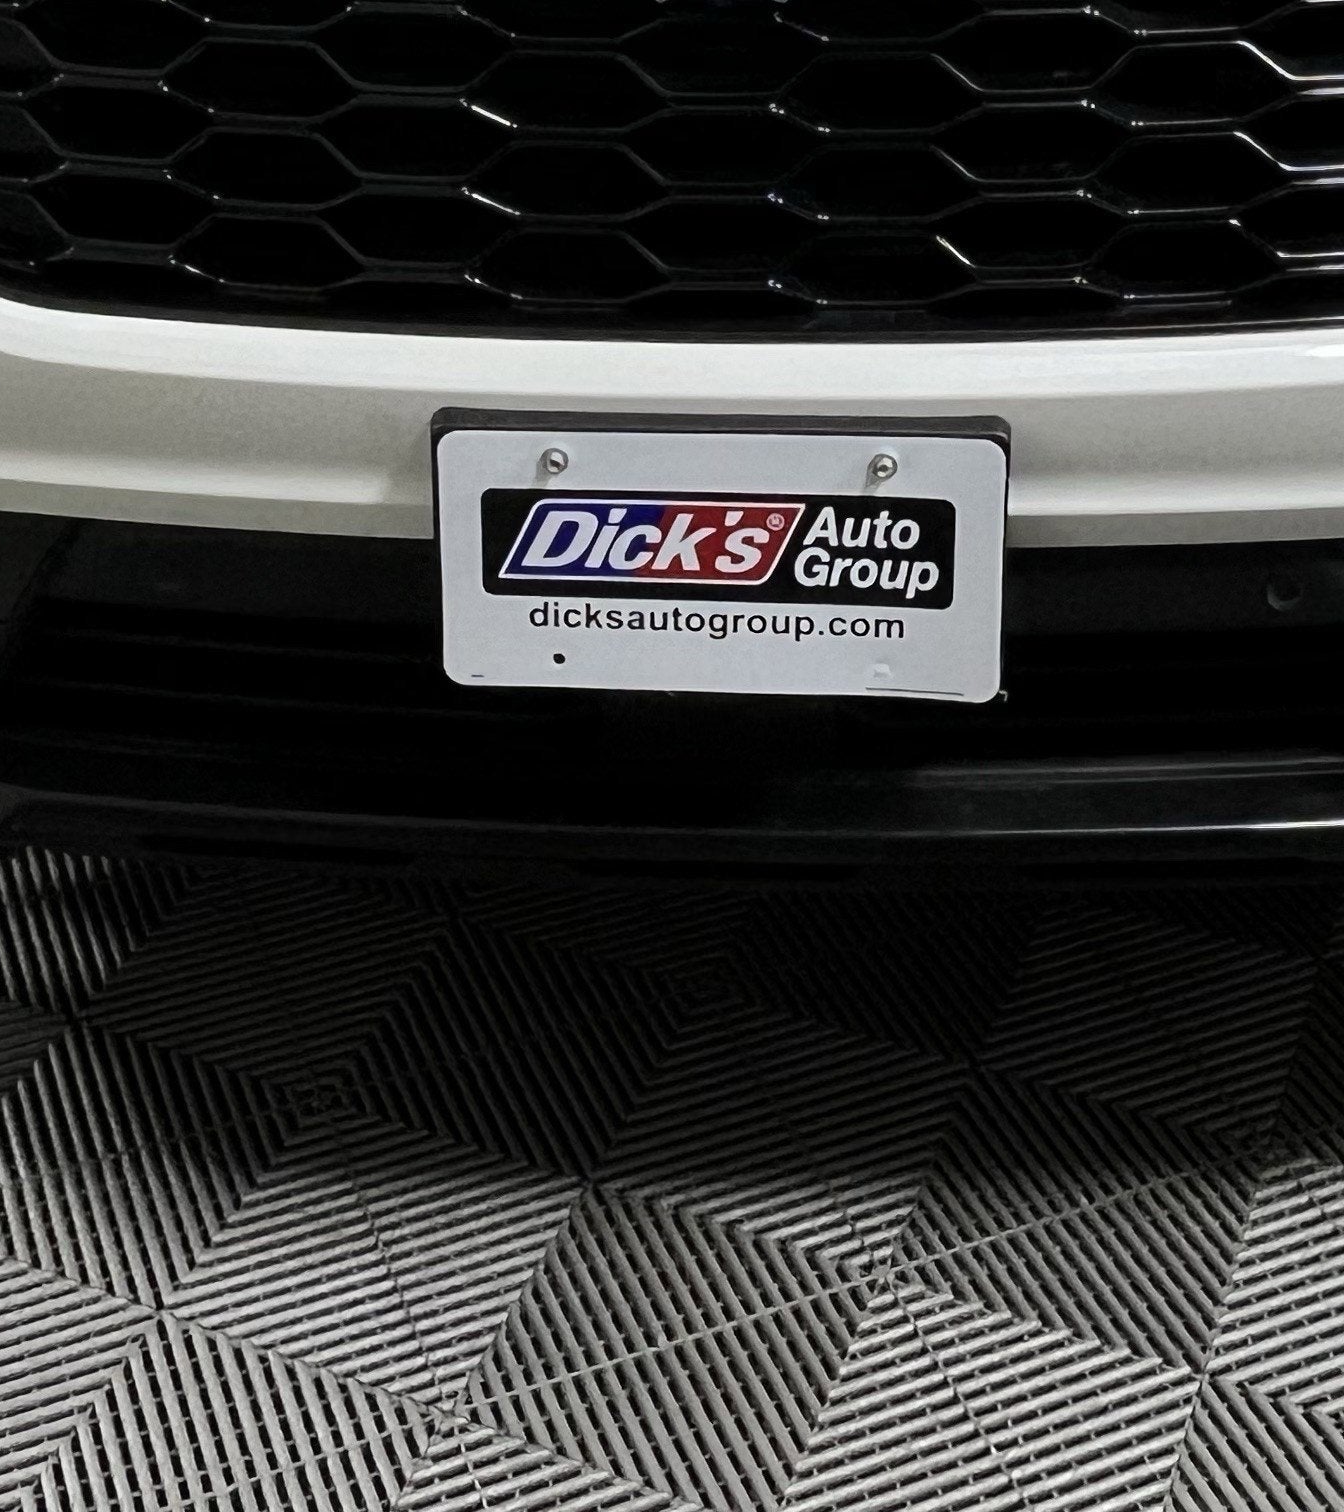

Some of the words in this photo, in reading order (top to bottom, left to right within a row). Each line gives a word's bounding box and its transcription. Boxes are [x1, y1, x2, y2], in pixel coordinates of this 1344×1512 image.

[803, 506, 921, 552] Auto
[793, 546, 940, 600] Group
[529, 601, 906, 642] dicksautogroup.com
